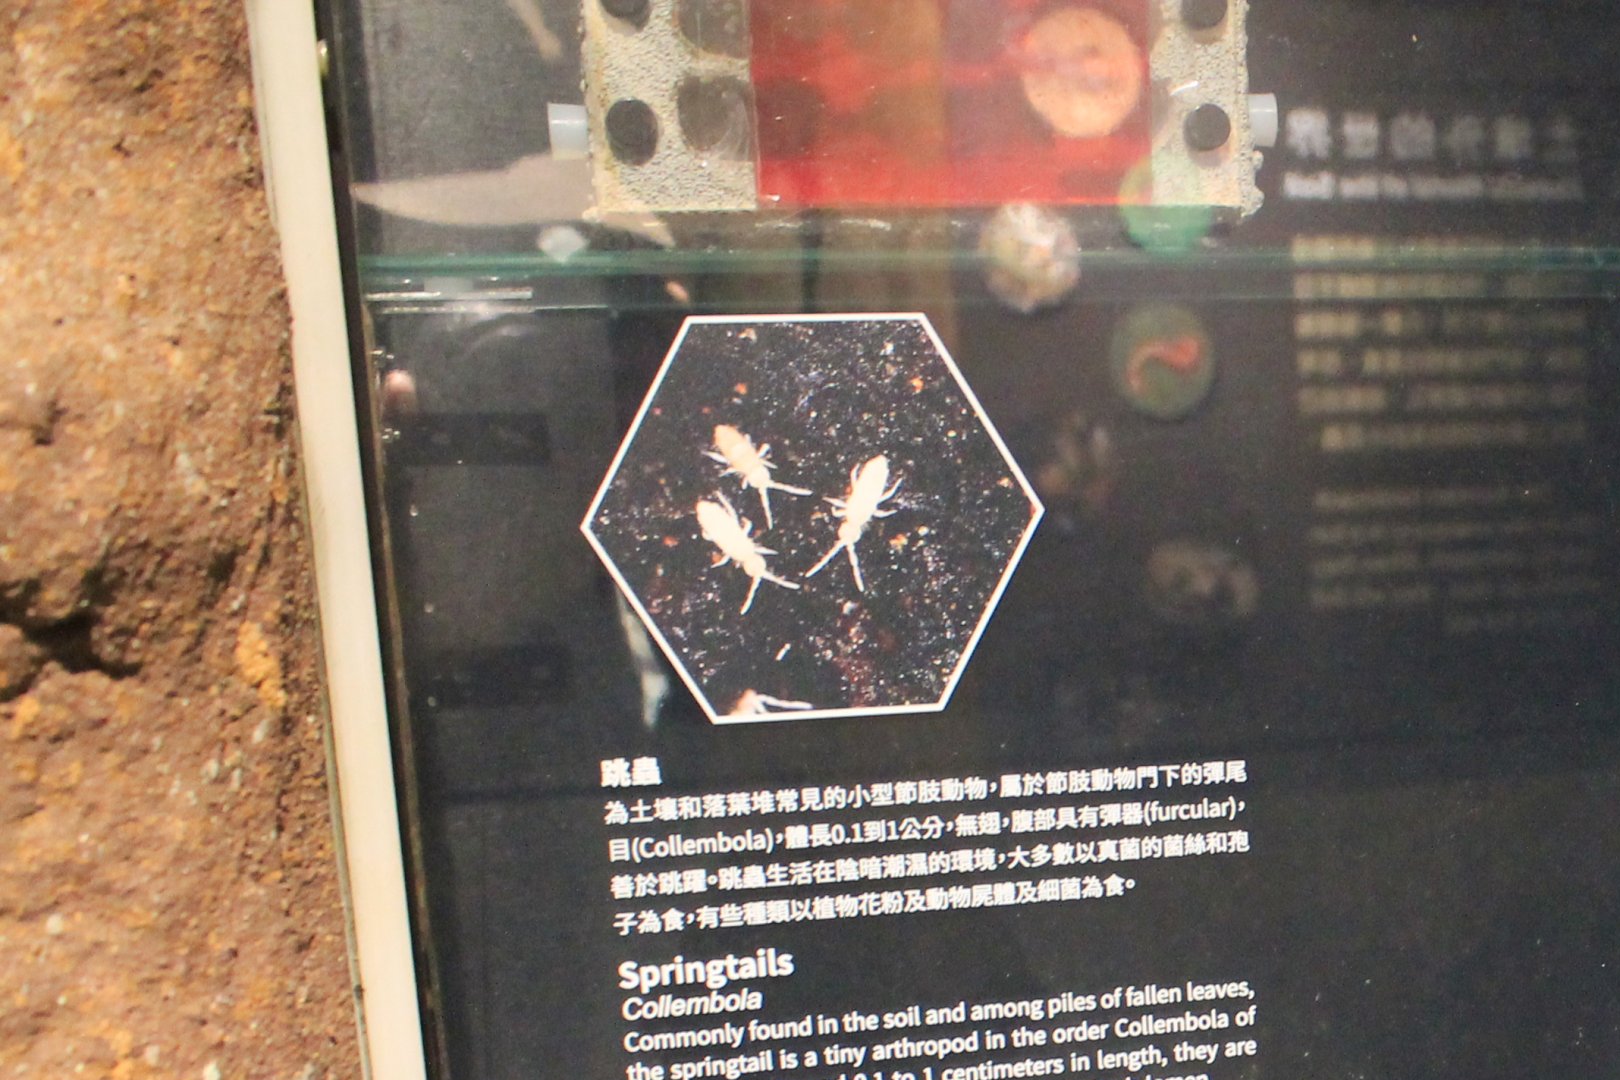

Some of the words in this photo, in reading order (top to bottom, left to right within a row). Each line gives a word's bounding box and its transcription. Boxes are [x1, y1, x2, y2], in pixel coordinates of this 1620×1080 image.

[601, 756, 662, 787] 跳蟲
[618, 948, 794, 994] Springtails
[622, 988, 762, 1020] Collembola
[624, 1023, 744, 1052] Commonly
[748, 1015, 812, 1041] found
[817, 1015, 838, 1034] in
[842, 1011, 879, 1032] the
[883, 1006, 921, 1029] soil
[925, 1001, 965, 1025] and
[971, 1000, 1044, 1021] among
[1048, 992, 1096, 1018] piles
[1100, 987, 1122, 1009] of
[1125, 984, 1181, 1007] fallen
[1187, 981, 1254, 1001] leaves,
[779, 1049, 798, 1069] is
[804, 1051, 817, 1067] a
[823, 1044, 866, 1067] tiny
[872, 1031, 978, 1060] arthropod
[985, 1030, 1005, 1049] in
[1011, 1026, 1047, 1047] the
[1052, 1021, 1109, 1043] order
[1115, 1009, 1229, 1037] Collembola
[1235, 1005, 1256, 1026] of
[1070, 1053, 1090, 1072] in
[1097, 1045, 1168, 1071] length,
[1173, 1041, 1218, 1064] they
[1225, 1040, 1257, 1057] are
